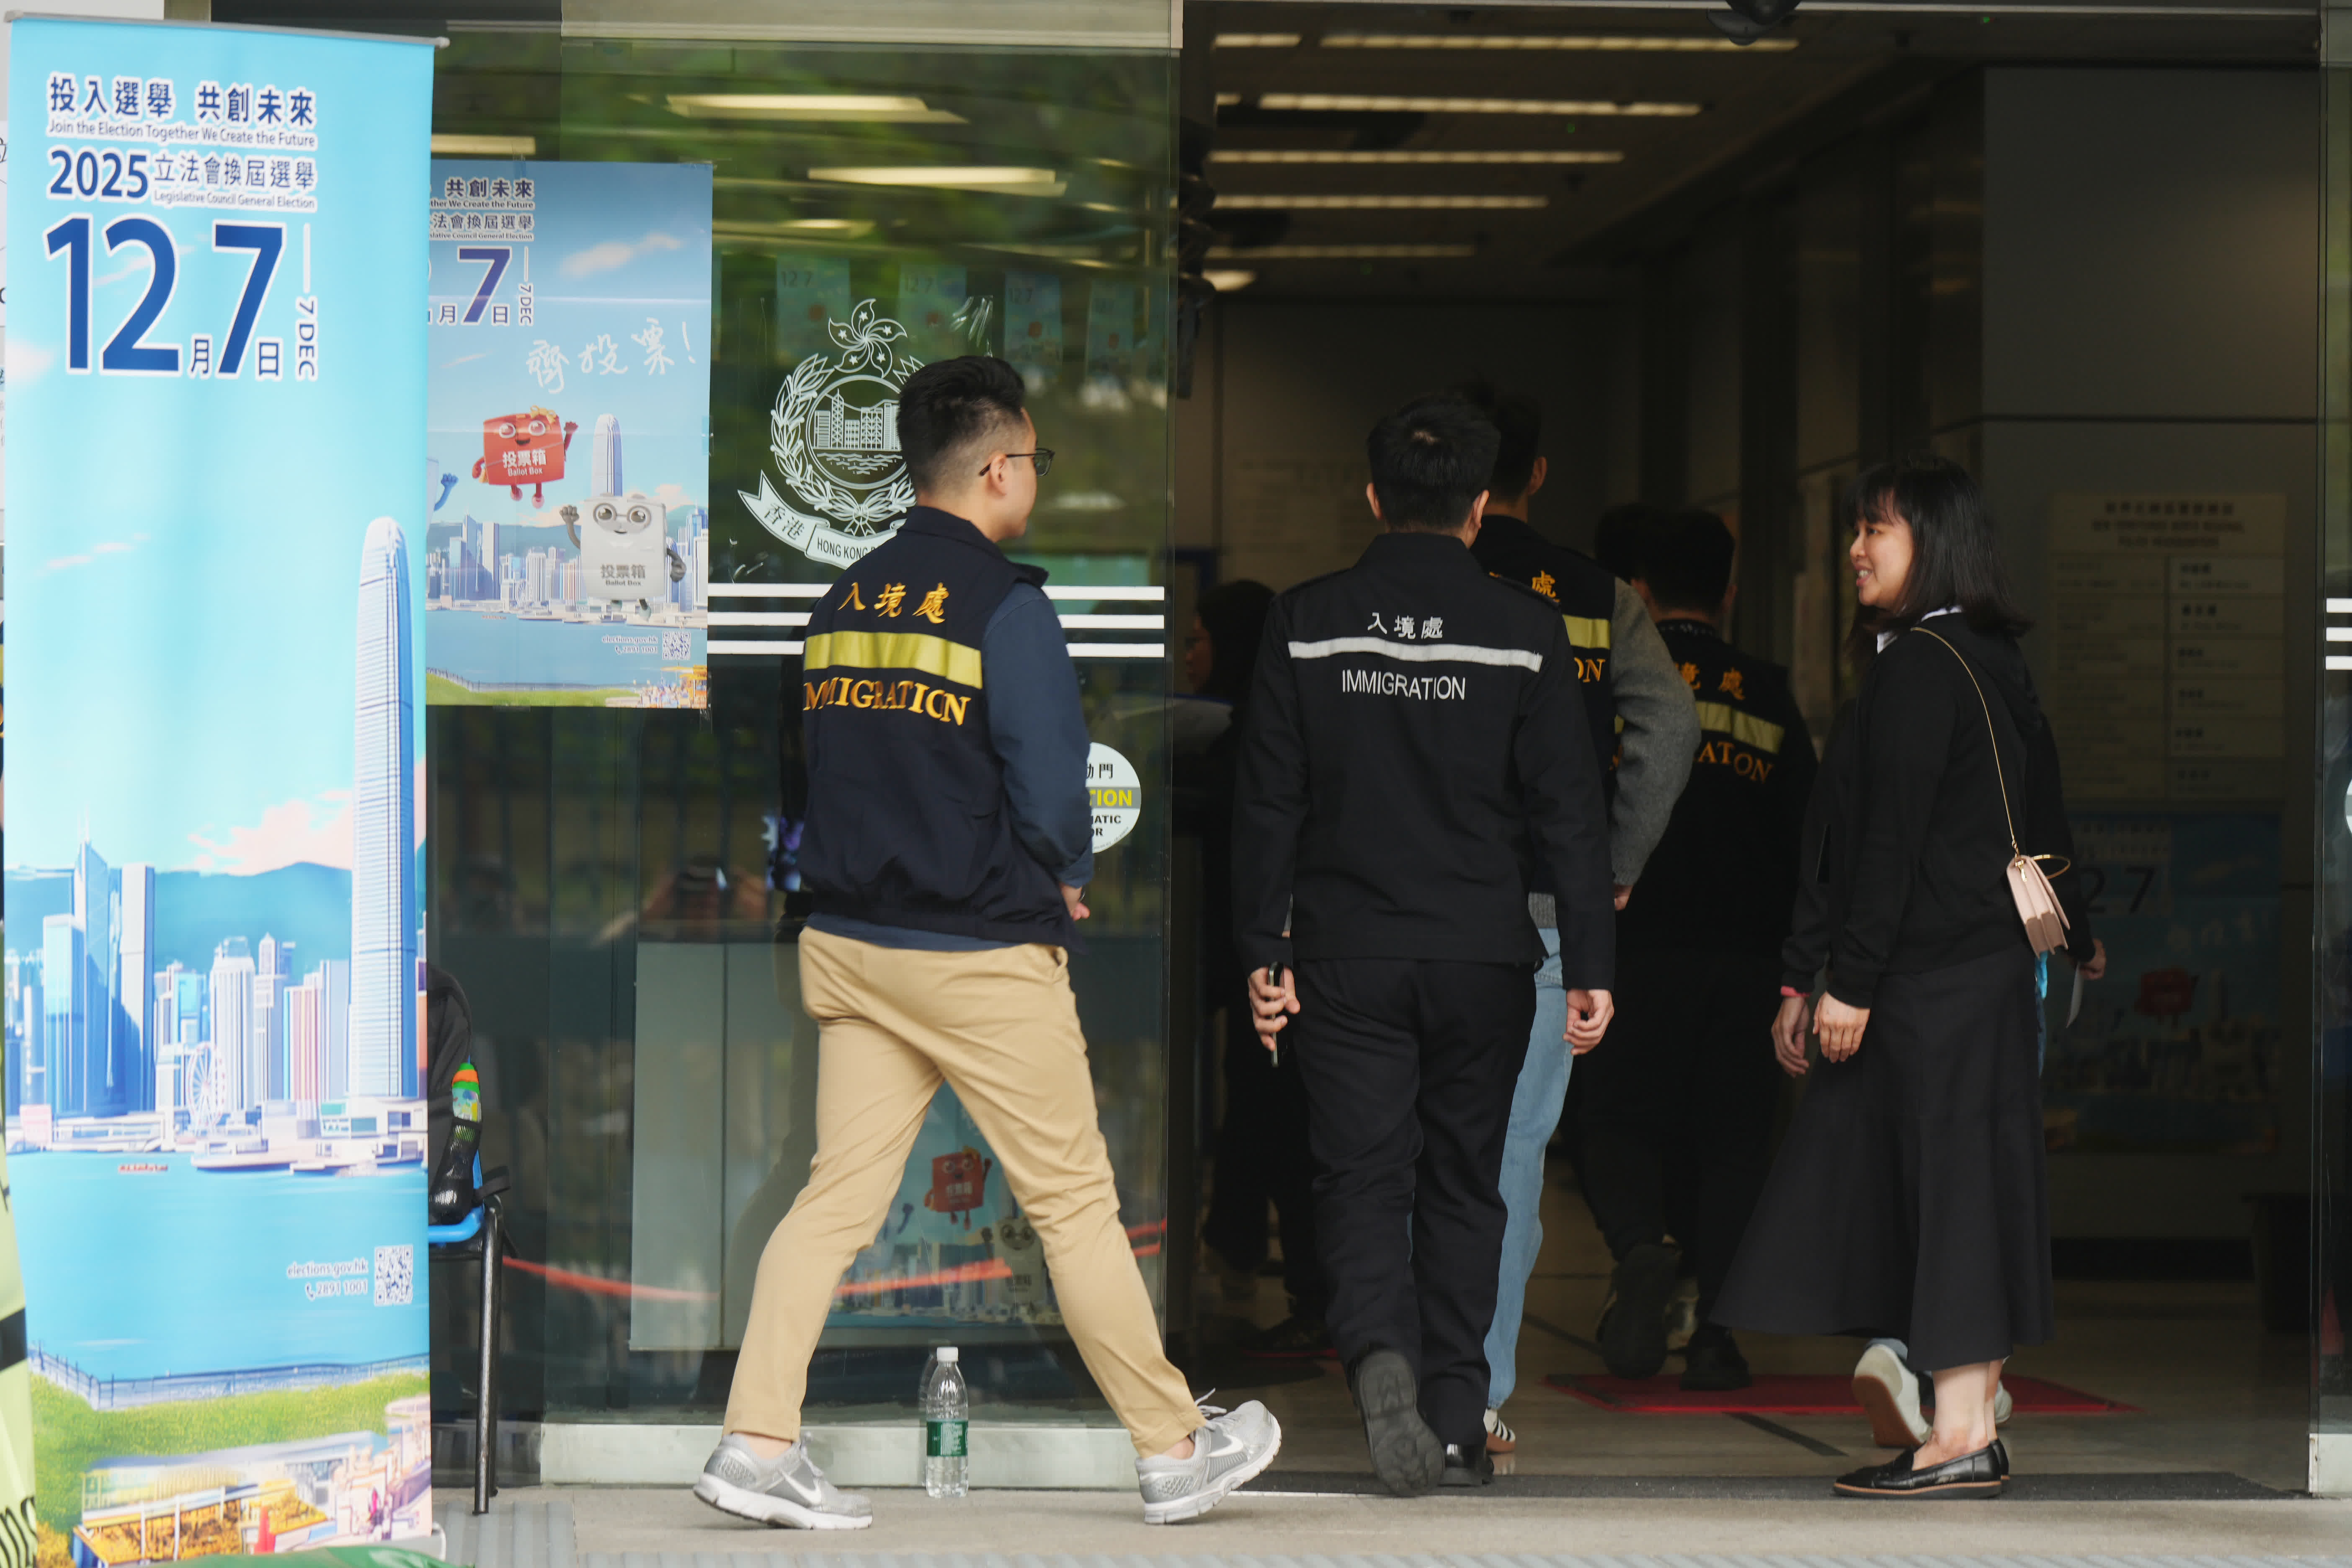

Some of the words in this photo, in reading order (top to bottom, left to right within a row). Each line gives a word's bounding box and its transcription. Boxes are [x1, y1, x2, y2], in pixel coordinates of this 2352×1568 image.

[50, 77, 172, 117] 投入選舉
[198, 85, 312, 126] 共創未來
[50, 119, 74, 133] Join
[77, 120, 95, 134] the
[99, 122, 143, 137] Election
[145, 124, 199, 142] Together
[201, 126, 218, 141] We
[221, 129, 253, 143] Create
[256, 131, 275, 144] the
[279, 132, 315, 147] Future
[50, 150, 148, 199] 2025
[155, 153, 314, 189] 立法會換屆選舉
[155, 190, 205, 204] Legislative
[207, 192, 236, 205] Council
[238, 194, 275, 206] General
[278, 196, 314, 208] Election
[446, 179, 533, 198] 共創未來
[430, 199, 447, 207] ther
[299, 300, 315, 314] 7
[520, 297, 531, 324] DEC
[299, 323, 315, 377] DEC
[503, 449, 547, 468] 投票箱
[508, 468, 528, 477] Ballot
[529, 466, 543, 475] Box
[764, 503, 805, 540] 香港
[817, 536, 841, 557] HONG
[837, 582, 950, 624] 入境處
[1367, 611, 1444, 640] 入境處
[1341, 669, 1466, 701] IMMIGRATION
[287, 1259, 366, 1277] elections.gov.hk
[345, 1280, 367, 1293] 1001
